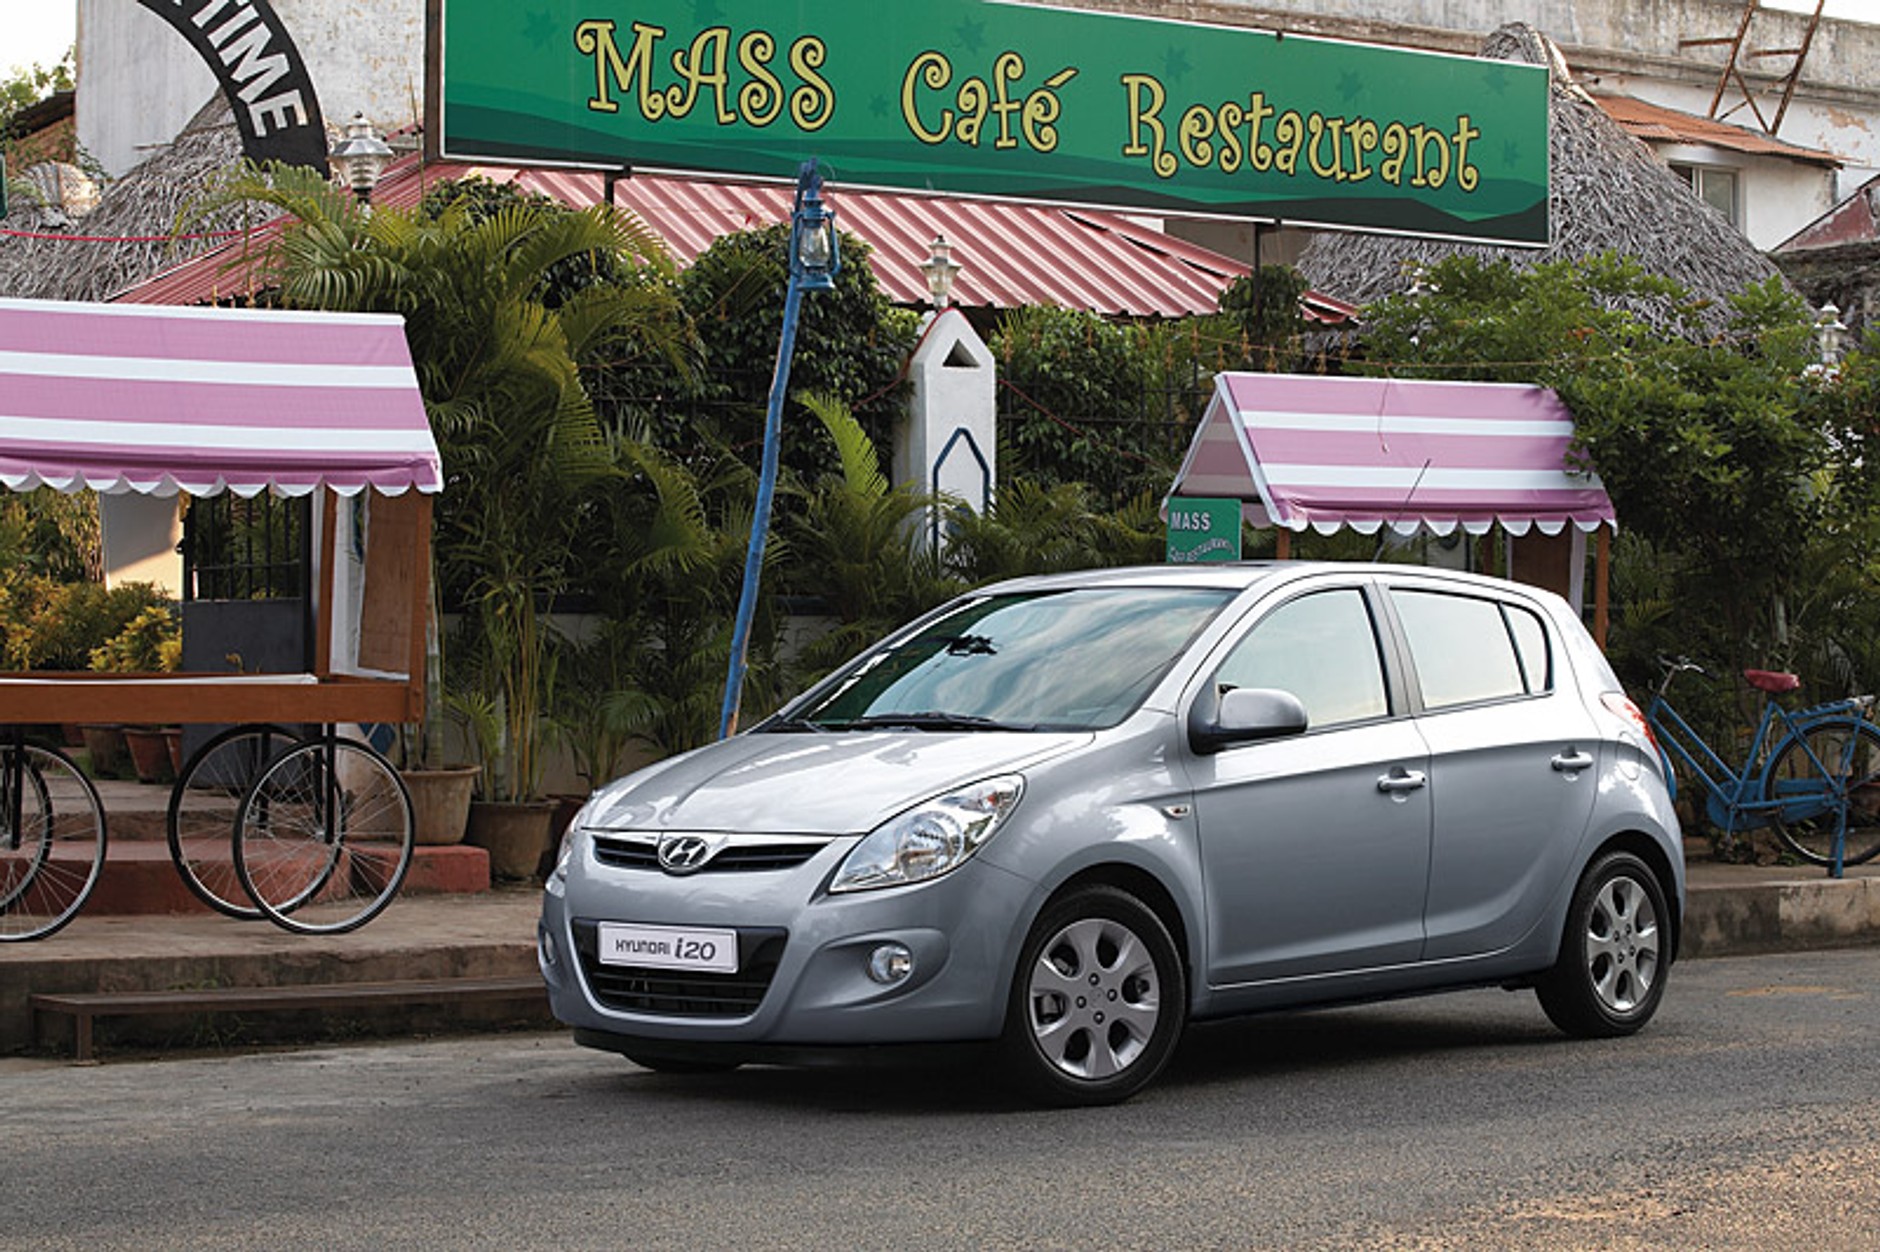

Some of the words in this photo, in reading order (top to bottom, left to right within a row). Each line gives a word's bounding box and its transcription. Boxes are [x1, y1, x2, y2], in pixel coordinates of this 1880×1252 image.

[574, 19, 834, 132] MASS
[901, 50, 1079, 152] Café
[1121, 74, 1480, 192] Restaurant
[1171, 512, 1211, 531] MASS
[615, 939, 671, 955] HYUNDAI
[675, 937, 716, 961] i20
